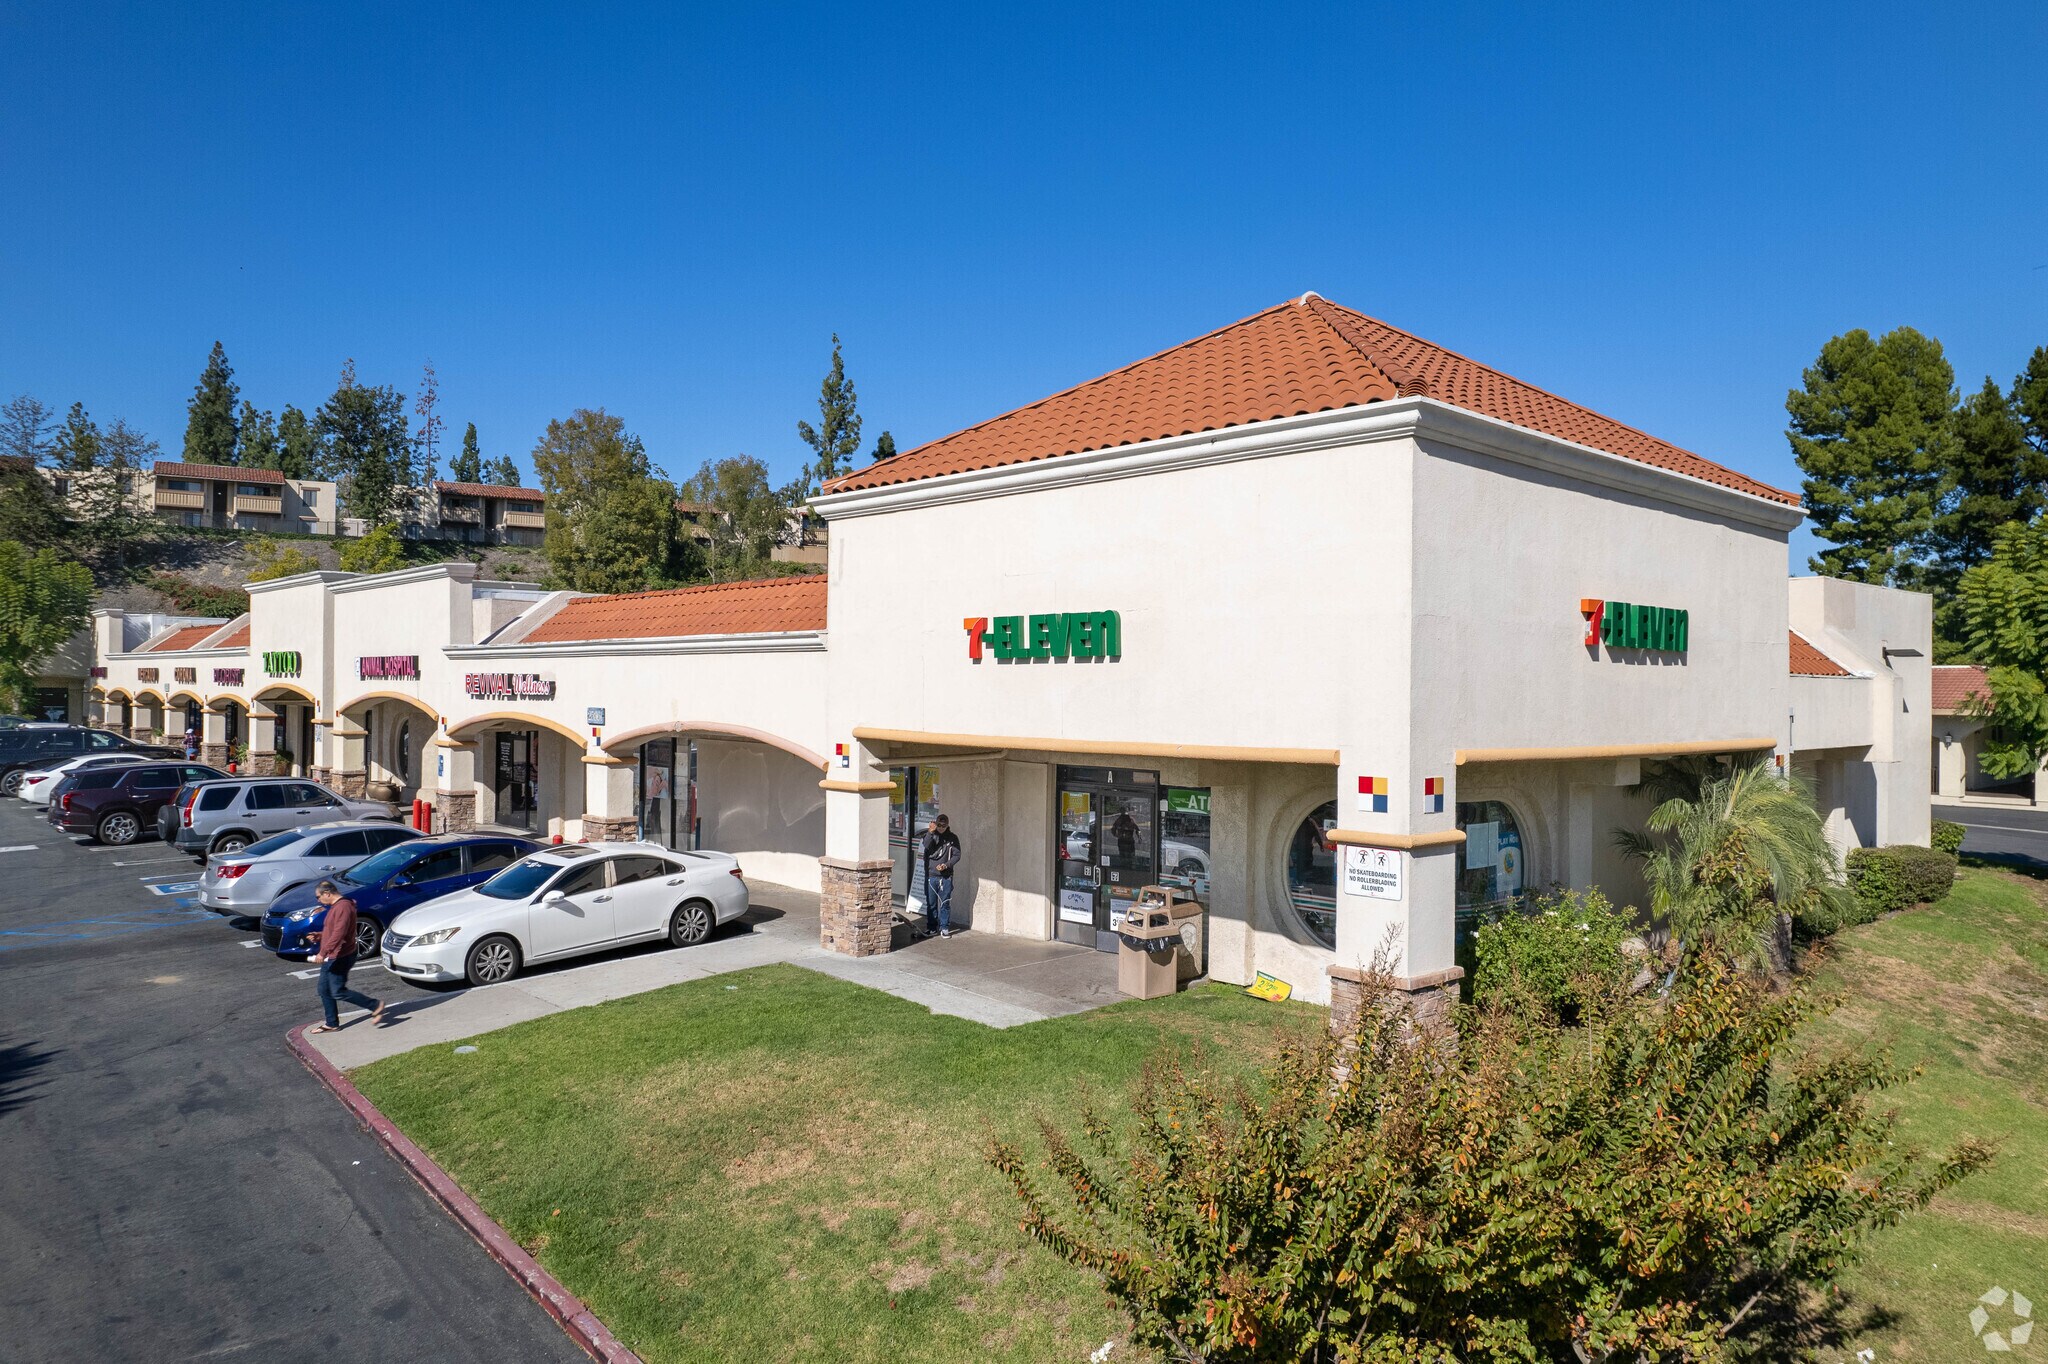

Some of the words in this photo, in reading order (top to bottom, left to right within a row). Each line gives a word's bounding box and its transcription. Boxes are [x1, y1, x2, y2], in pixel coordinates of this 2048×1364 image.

[263, 651, 298, 673] TATTOO
[361, 656, 384, 676] ANIMAL
[385, 655, 416, 676] HOSPITAL
[213, 667, 240, 683] FLORIST
[465, 674, 512, 695] REVIVAL
[512, 673, 551, 695] Wellness
[1107, 770, 1113, 783] A
[1357, 869, 1397, 879] SKATEBOARDING
[1357, 877, 1397, 887] ROLLERBLADING
